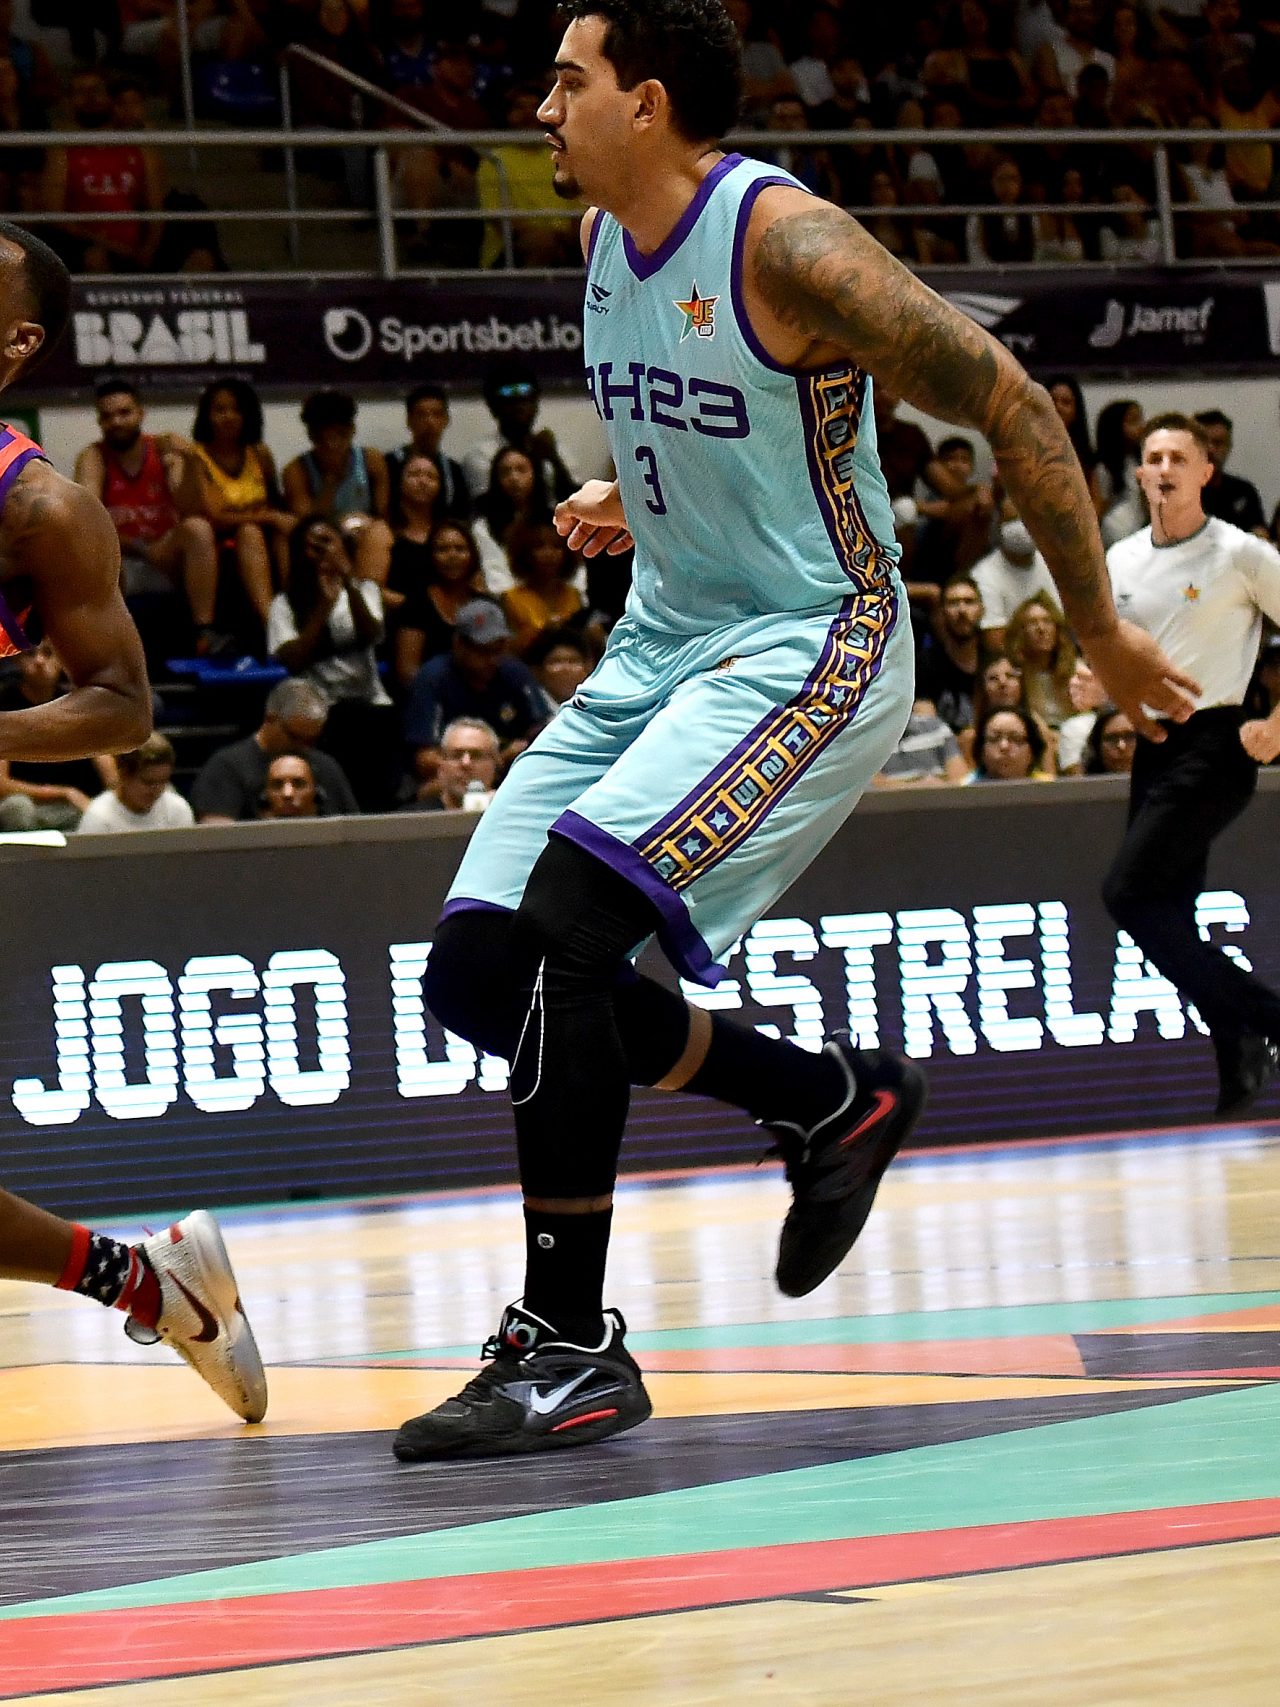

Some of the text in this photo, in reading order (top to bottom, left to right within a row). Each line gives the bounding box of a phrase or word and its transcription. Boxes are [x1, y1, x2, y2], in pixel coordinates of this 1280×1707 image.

[74, 310, 266, 366] BRASIL
[378, 315, 582, 361] Sportsbet.io
[635, 445, 668, 516] 3
[11, 948, 352, 1126] JOGO
